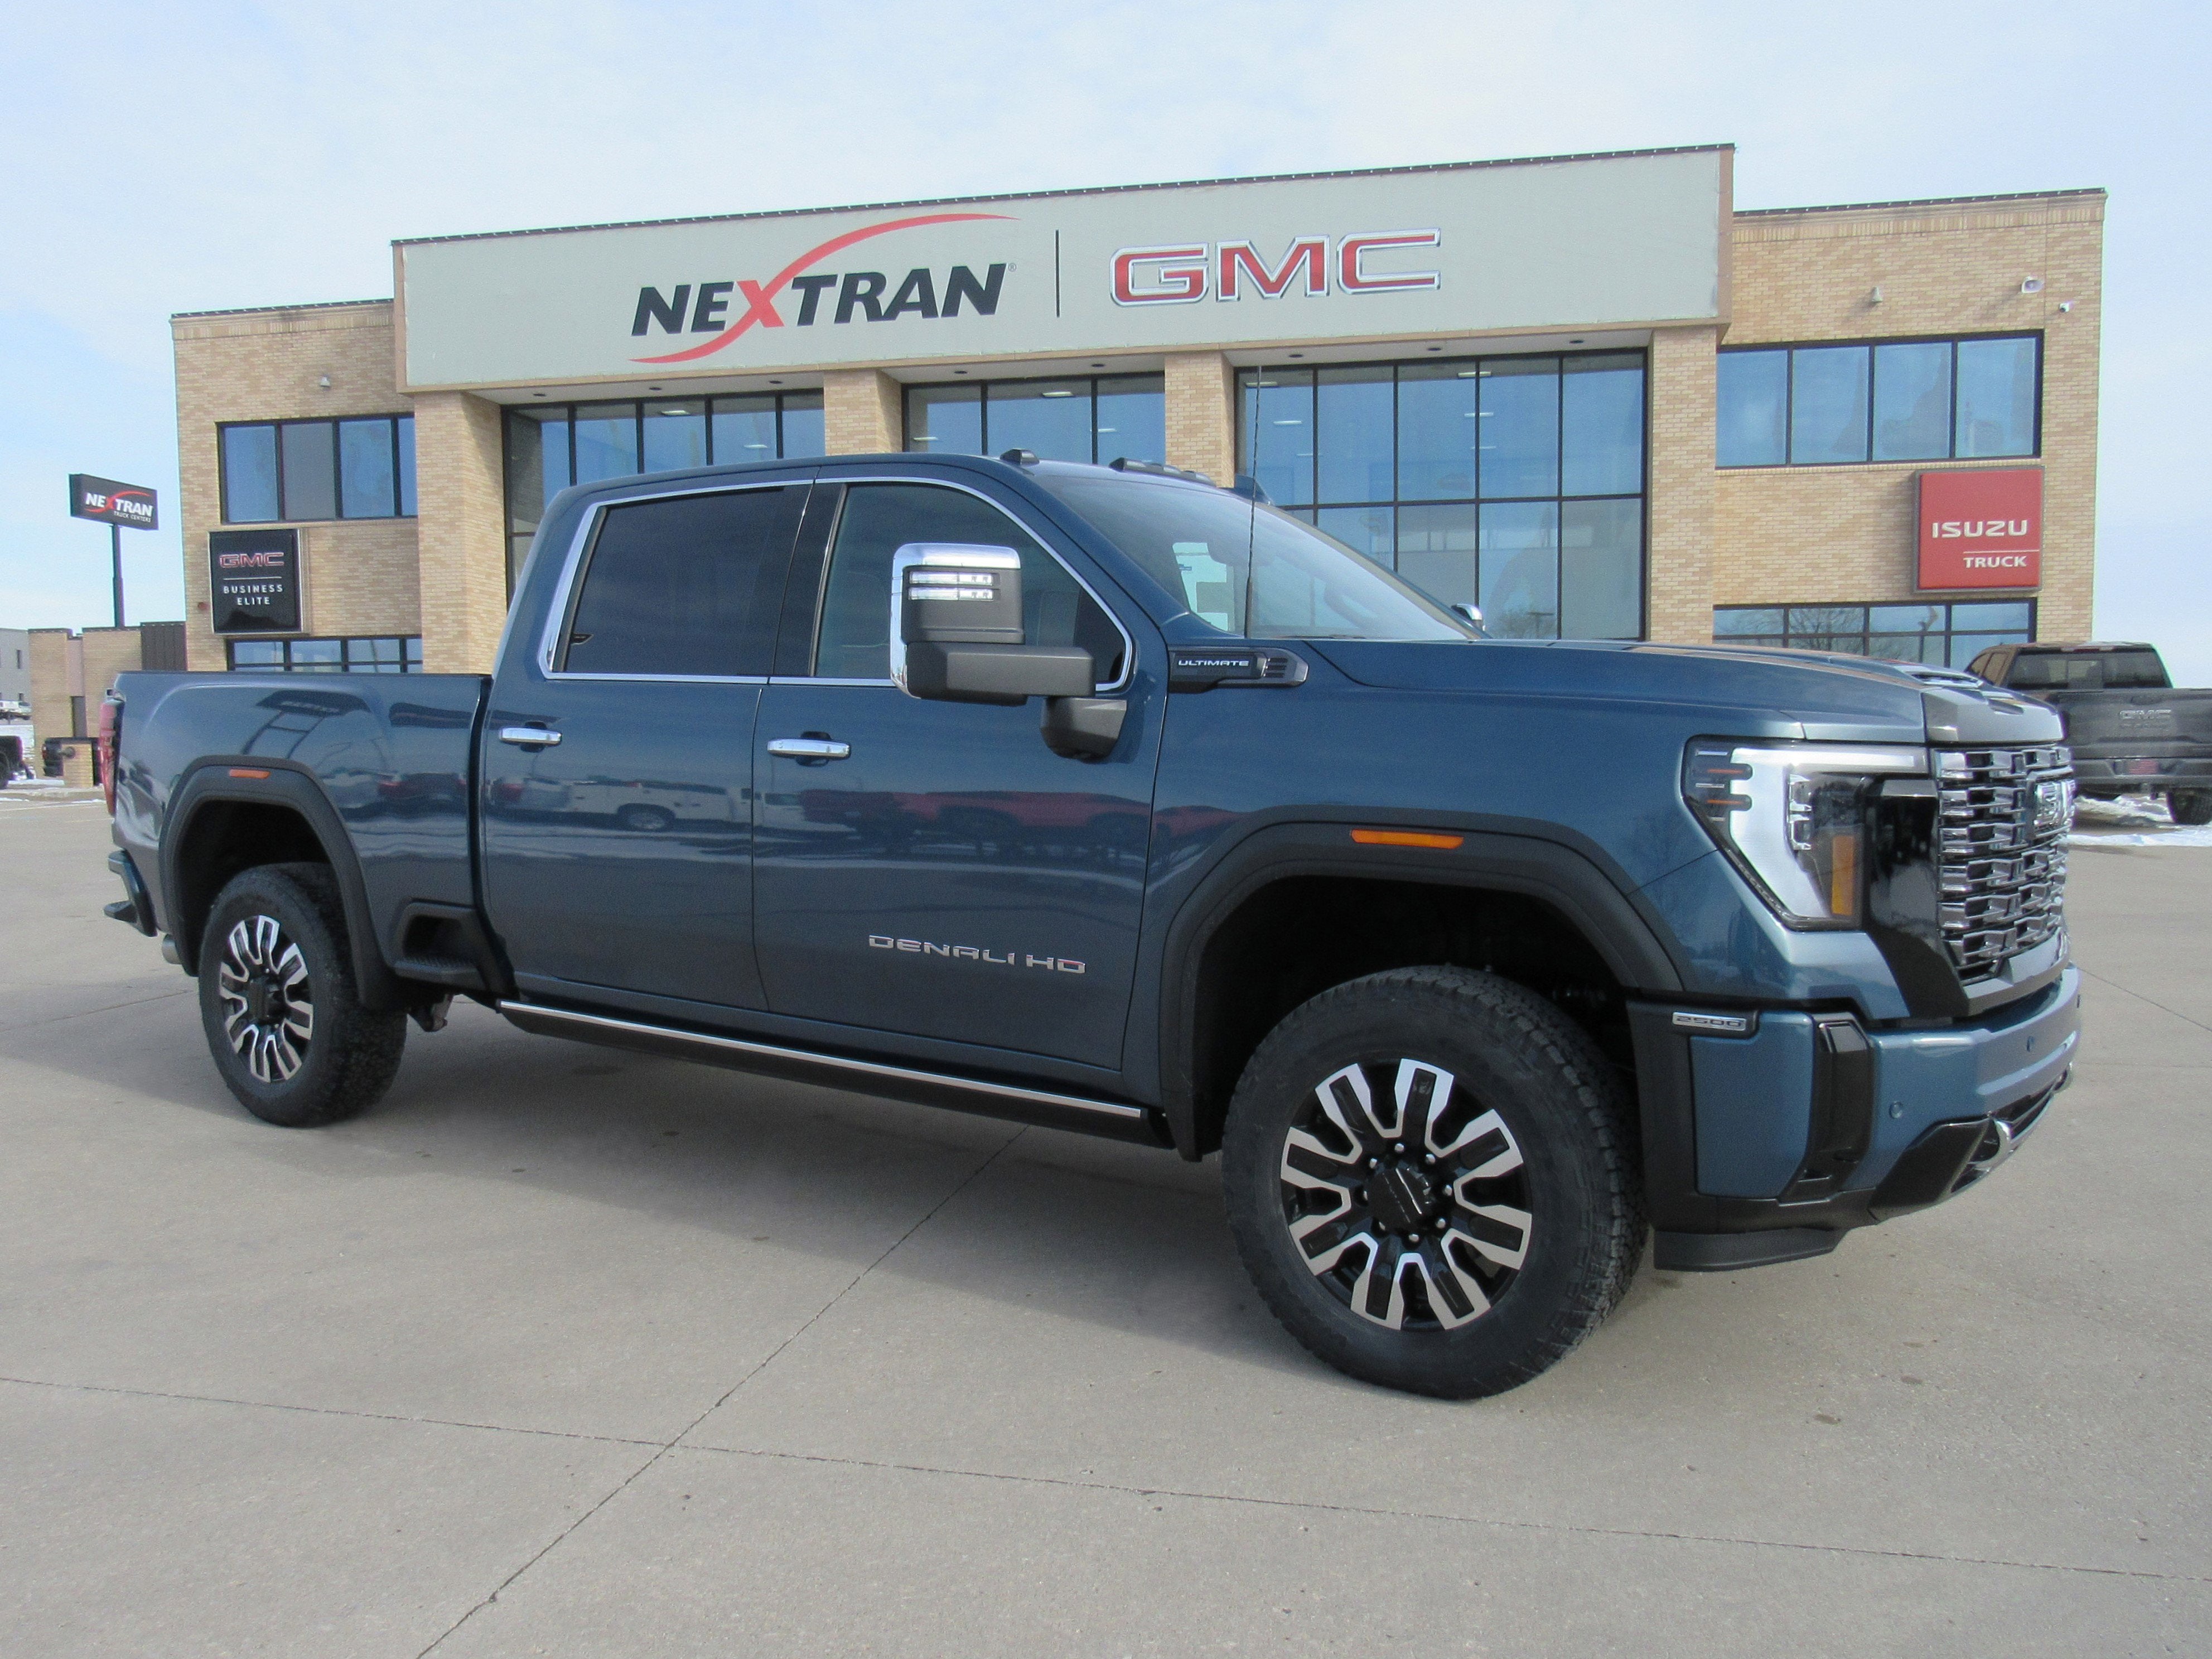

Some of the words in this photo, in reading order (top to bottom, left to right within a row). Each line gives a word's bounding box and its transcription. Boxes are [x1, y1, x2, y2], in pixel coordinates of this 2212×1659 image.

[1110, 228, 1441, 307] GMC
[631, 263, 1007, 336] NEXTRAN
[85, 493, 152, 517] NEXTRAN
[1931, 519, 2027, 538] ISUZU
[219, 552, 284, 568] GMC
[1963, 556, 2027, 568] TRUCK
[224, 584, 283, 594] BUSINESS
[237, 596, 271, 605] ELITE
[2120, 709, 2171, 720] GMC
[869, 935, 1015, 965] DENALI
[1026, 954, 1085, 973] HD
[1676, 1016, 1741, 1027] 2500
